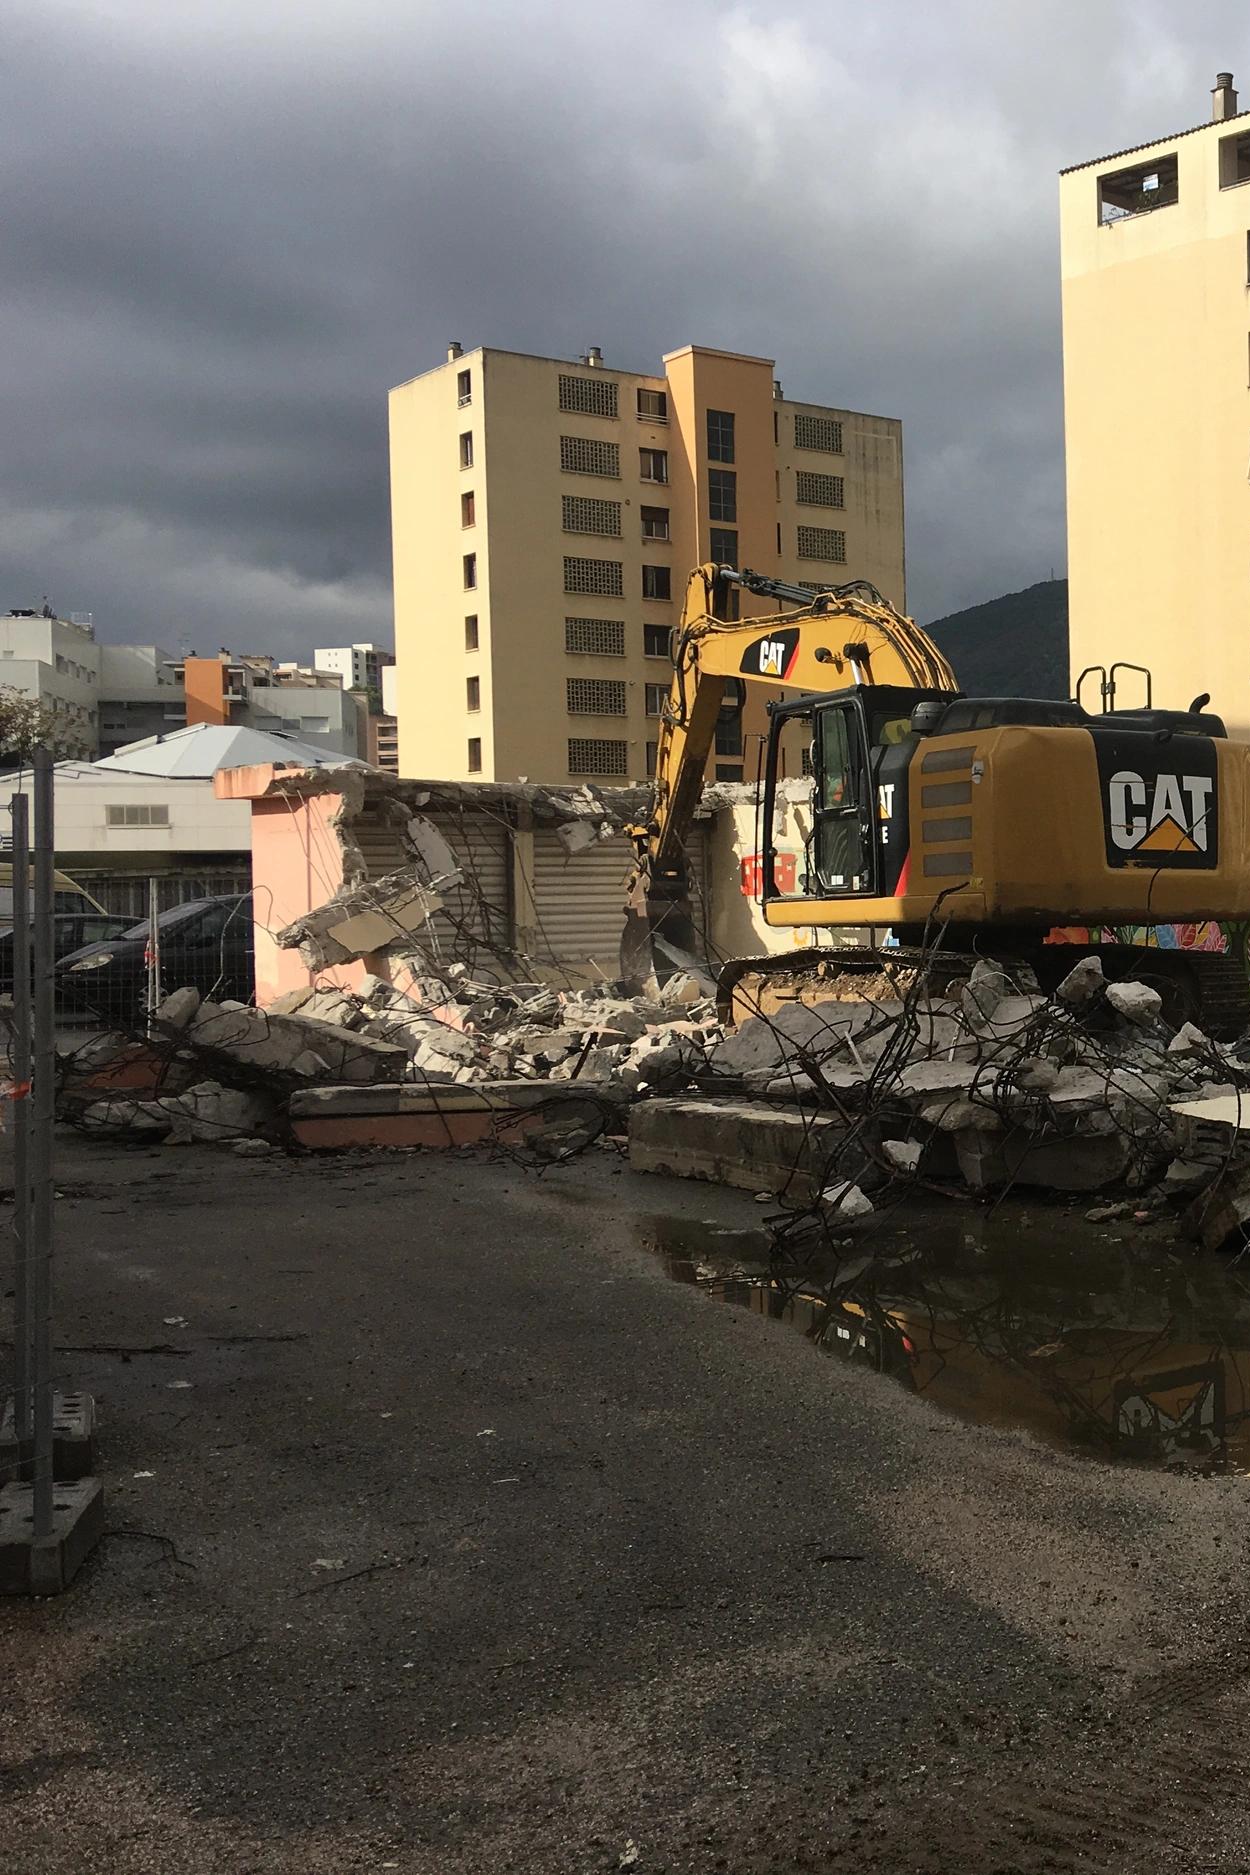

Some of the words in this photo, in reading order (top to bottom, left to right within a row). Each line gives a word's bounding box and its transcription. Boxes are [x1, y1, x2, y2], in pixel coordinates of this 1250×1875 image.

[760, 640, 785, 675] CAT
[879, 783, 895, 819] AT
[1109, 771, 1213, 851] CAT
